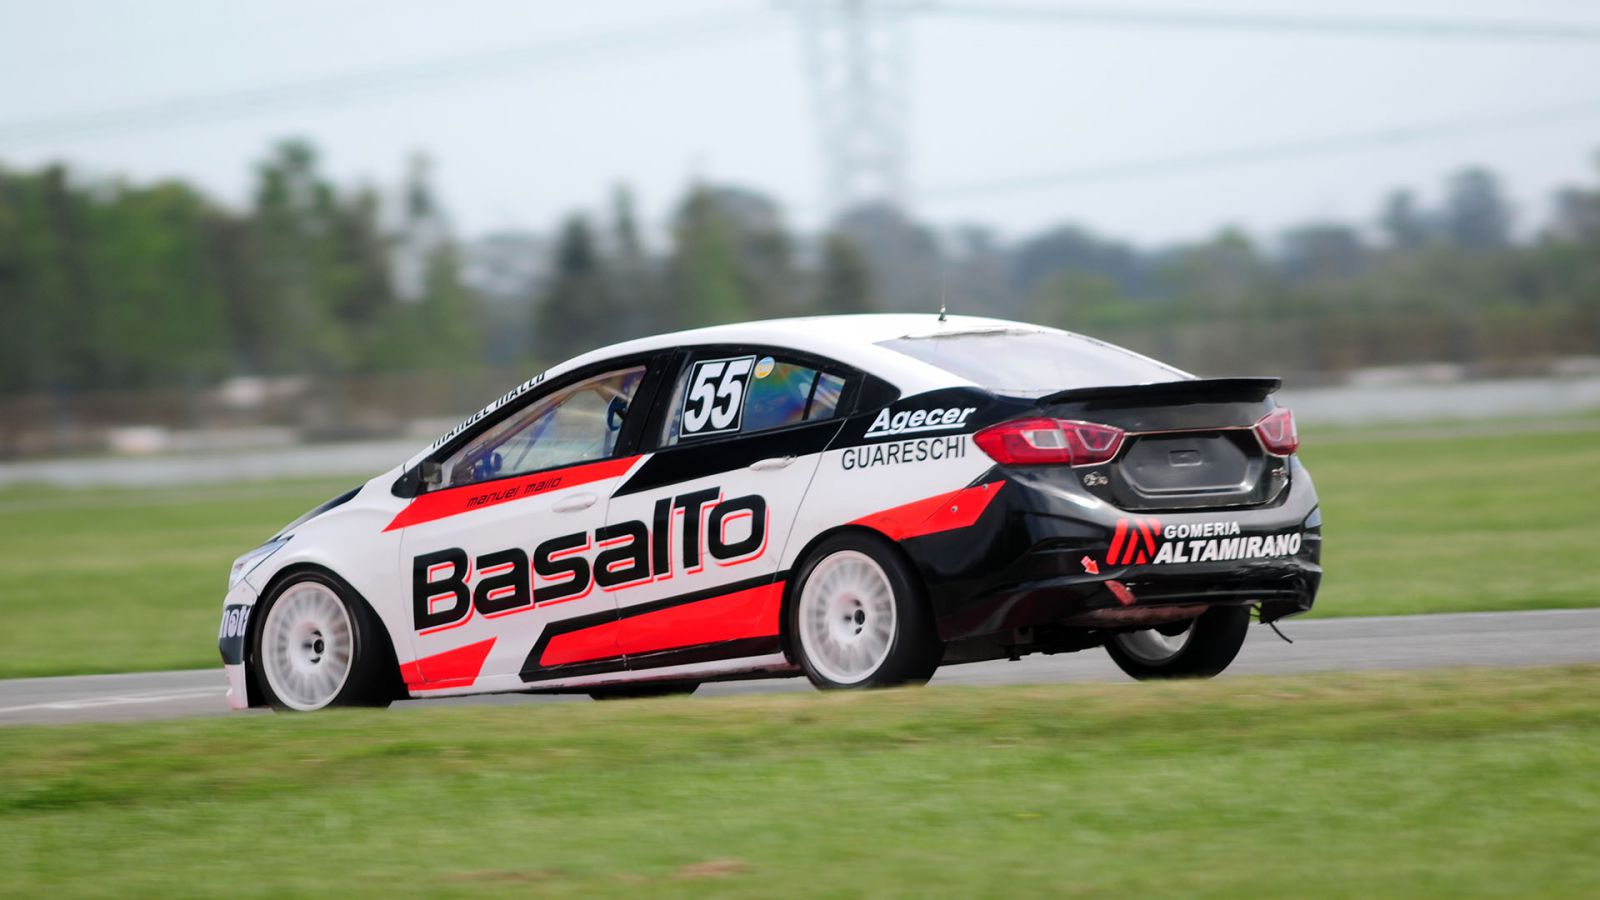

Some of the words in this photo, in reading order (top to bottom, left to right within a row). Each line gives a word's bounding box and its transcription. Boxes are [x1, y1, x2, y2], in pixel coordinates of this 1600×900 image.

[684, 359, 753, 432] 55
[867, 407, 977, 435] Agecer
[841, 436, 966, 470] GUARESCHI
[466, 485, 520, 508] manuel
[1163, 521, 1241, 539] GOMERIA
[1152, 532, 1302, 564] ALTAMIRANO
